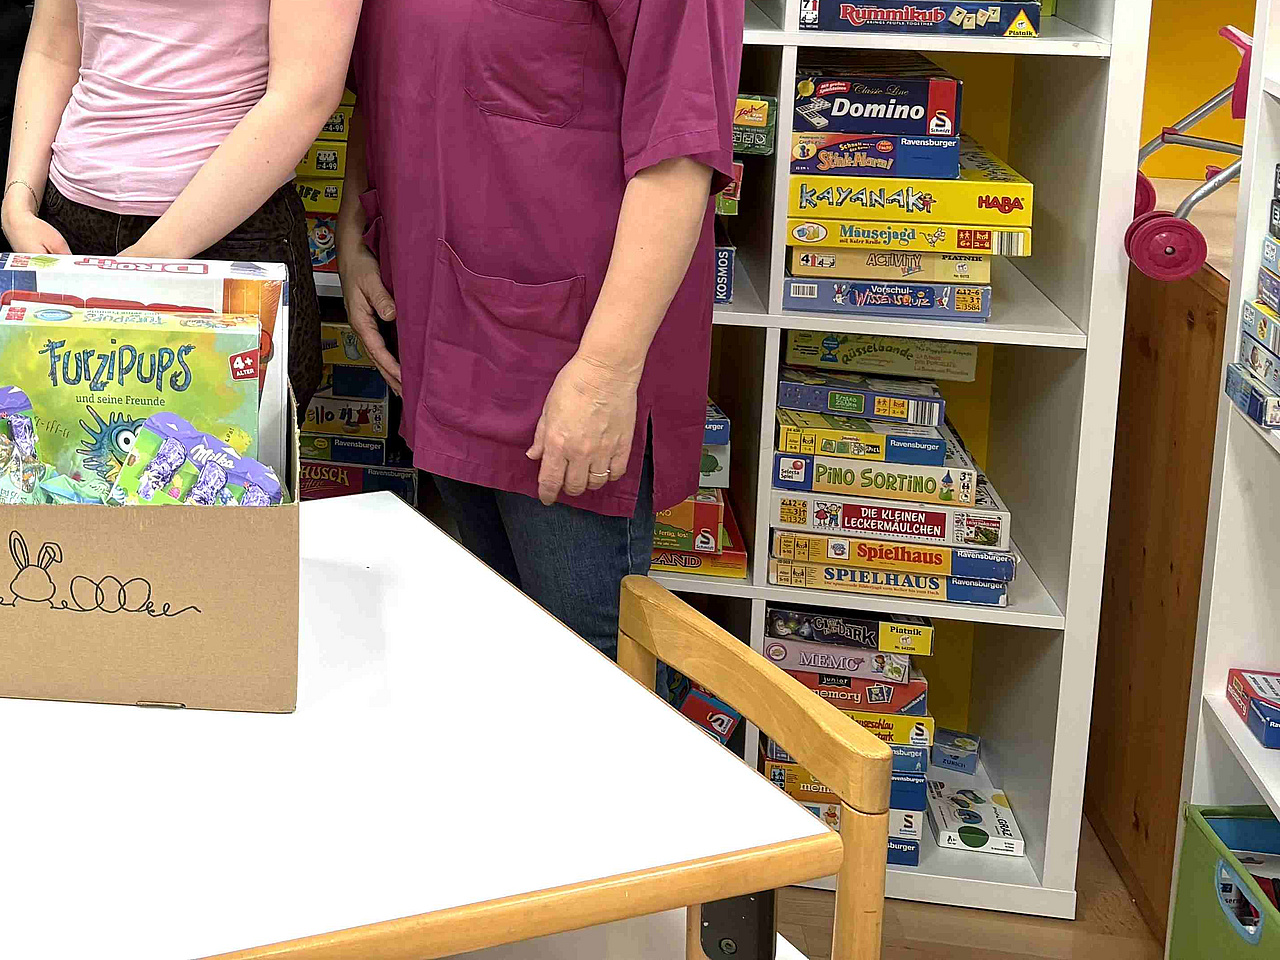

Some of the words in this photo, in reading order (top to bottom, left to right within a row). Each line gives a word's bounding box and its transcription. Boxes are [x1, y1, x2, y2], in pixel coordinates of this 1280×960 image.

[840, 4, 946, 26] Rummikub
[831, 98, 925, 119] Domino
[901, 138, 956, 147] Ravensburger
[799, 184, 925, 213] KAYANAK
[978, 195, 1024, 214] HABA
[839, 224, 916, 246] Mäusejagd
[866, 253, 922, 267] ACTIVITY
[717, 251, 729, 300] KOSMOS
[871, 285, 913, 295] Vorschul-
[39, 338, 196, 392] FURZIPUPS
[232, 355, 253, 370] 4+
[237, 369, 254, 377] ALTER
[76, 394, 95, 404] und
[97, 395, 123, 404] seine
[125, 395, 165, 406] Freunde
[334, 439, 381, 450] Ravensburger
[890, 440, 940, 451] Ravensburger
[189, 444, 235, 468] Milka
[815, 465, 855, 485] PINO
[861, 469, 937, 494] SORTINO
[861, 507, 880, 519] DIE
[881, 510, 926, 524] KLEINEN
[844, 515, 942, 536] LECKERMÄULCHEN
[857, 543, 943, 565] Spielhaus
[957, 550, 1008, 562] Ravensburger
[824, 568, 941, 589] SPIELHAUS
[952, 578, 1004, 589] Ravensburger
[890, 626, 922, 635] Piatnik
[799, 652, 859, 670] MEMO
[821, 675, 848, 684] junior
